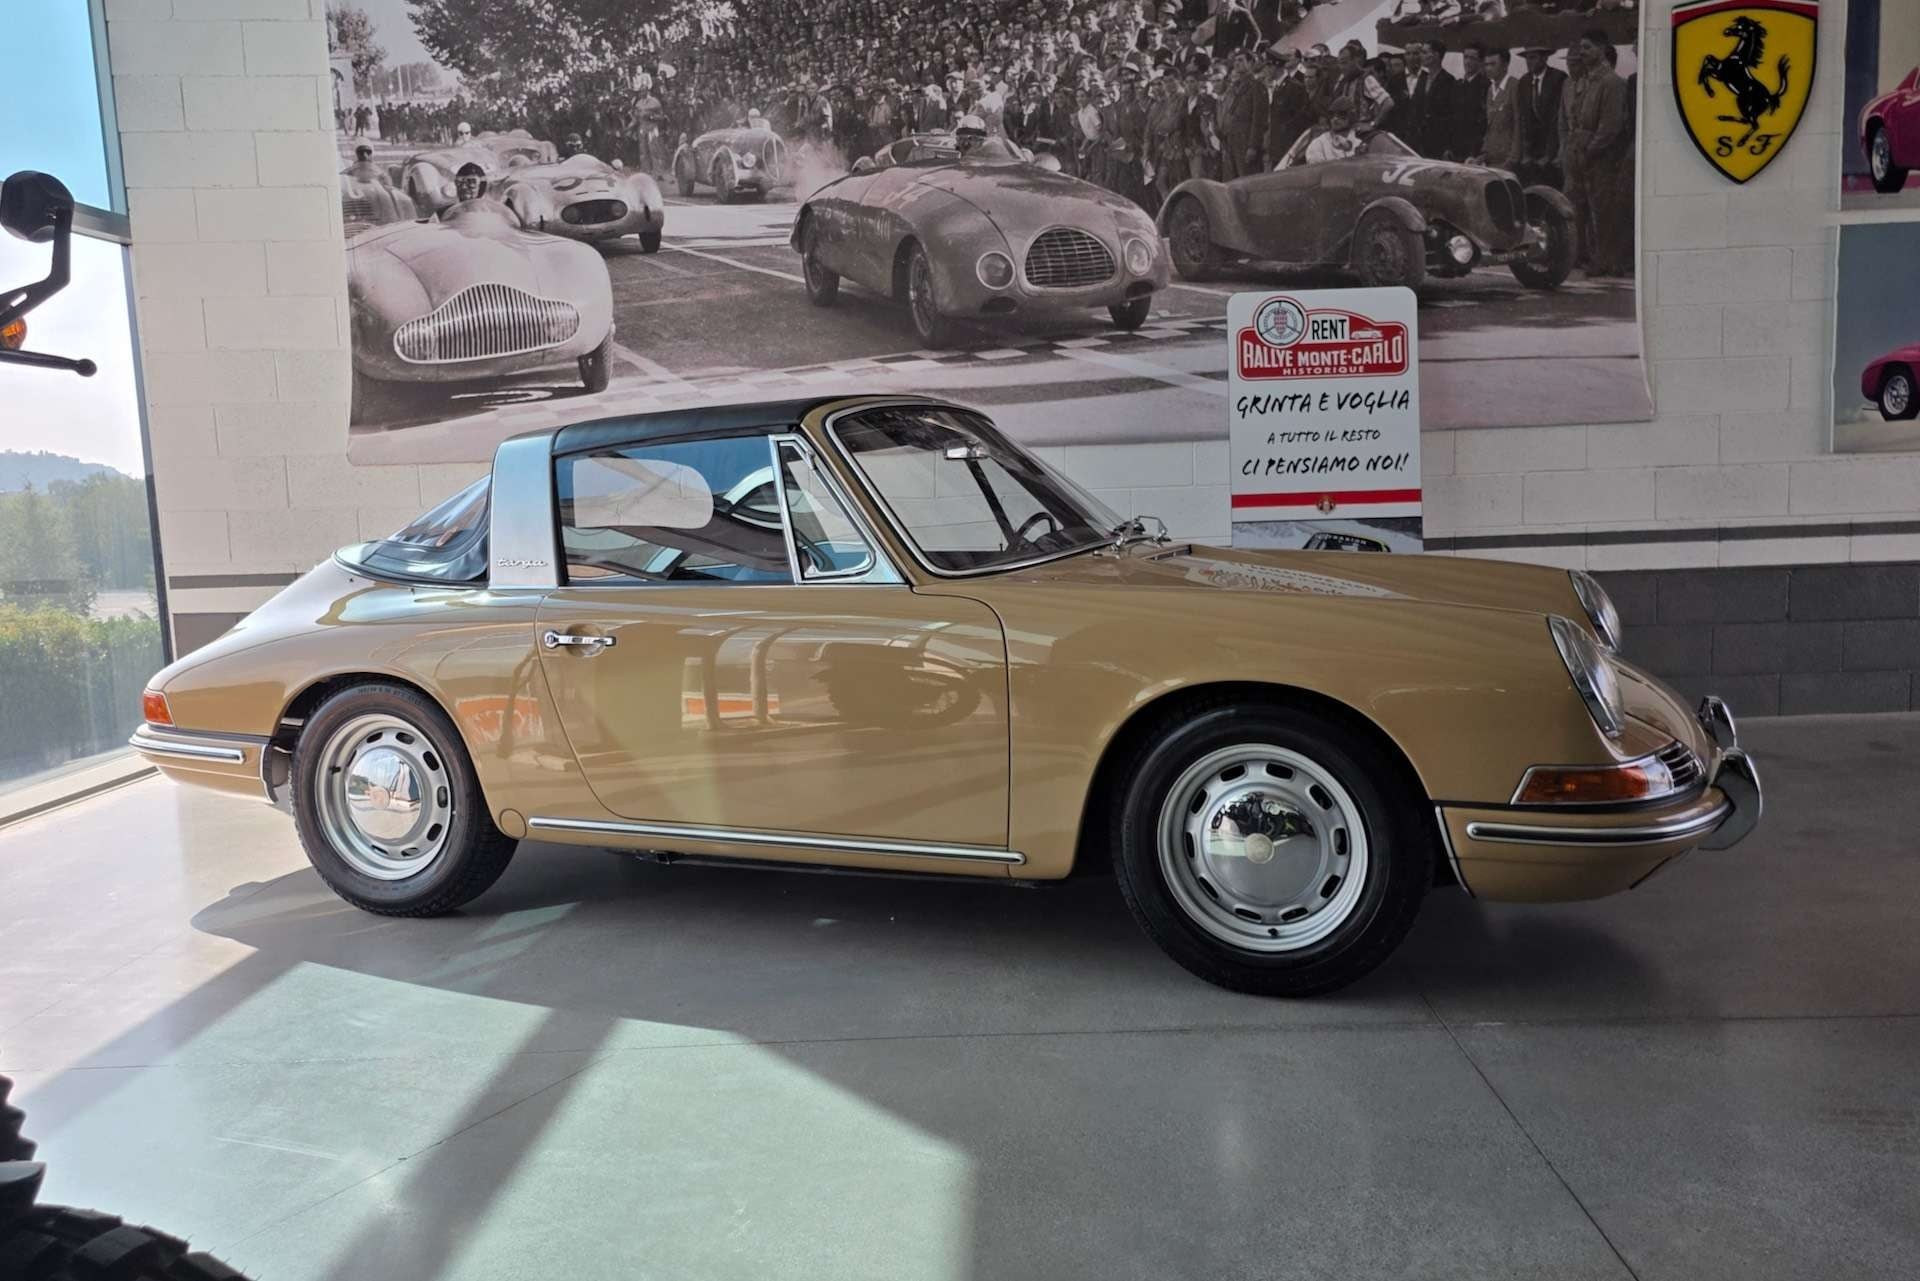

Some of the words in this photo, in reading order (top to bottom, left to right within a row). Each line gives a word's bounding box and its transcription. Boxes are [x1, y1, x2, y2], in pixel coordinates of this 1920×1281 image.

[1716, 136, 1734, 157] S
[1312, 319, 1347, 340] RENT
[1243, 340, 1294, 368] RALLYE
[1297, 335, 1403, 367] MONTE-CARLO
[1283, 366, 1365, 375] HISTORIQUE
[1237, 392, 1312, 419] GRINTA
[1319, 392, 1330, 411] E
[1337, 389, 1409, 415] VOGLIA
[1267, 432, 1275, 444] A
[1280, 431, 1320, 443] TUTTO
[1324, 430, 1337, 442] IL
[1341, 429, 1381, 442] RESTO
[1242, 458, 1260, 475] CI
[1265, 455, 1360, 476] PENSIAMO
[1366, 452, 1409, 472] NOI!
